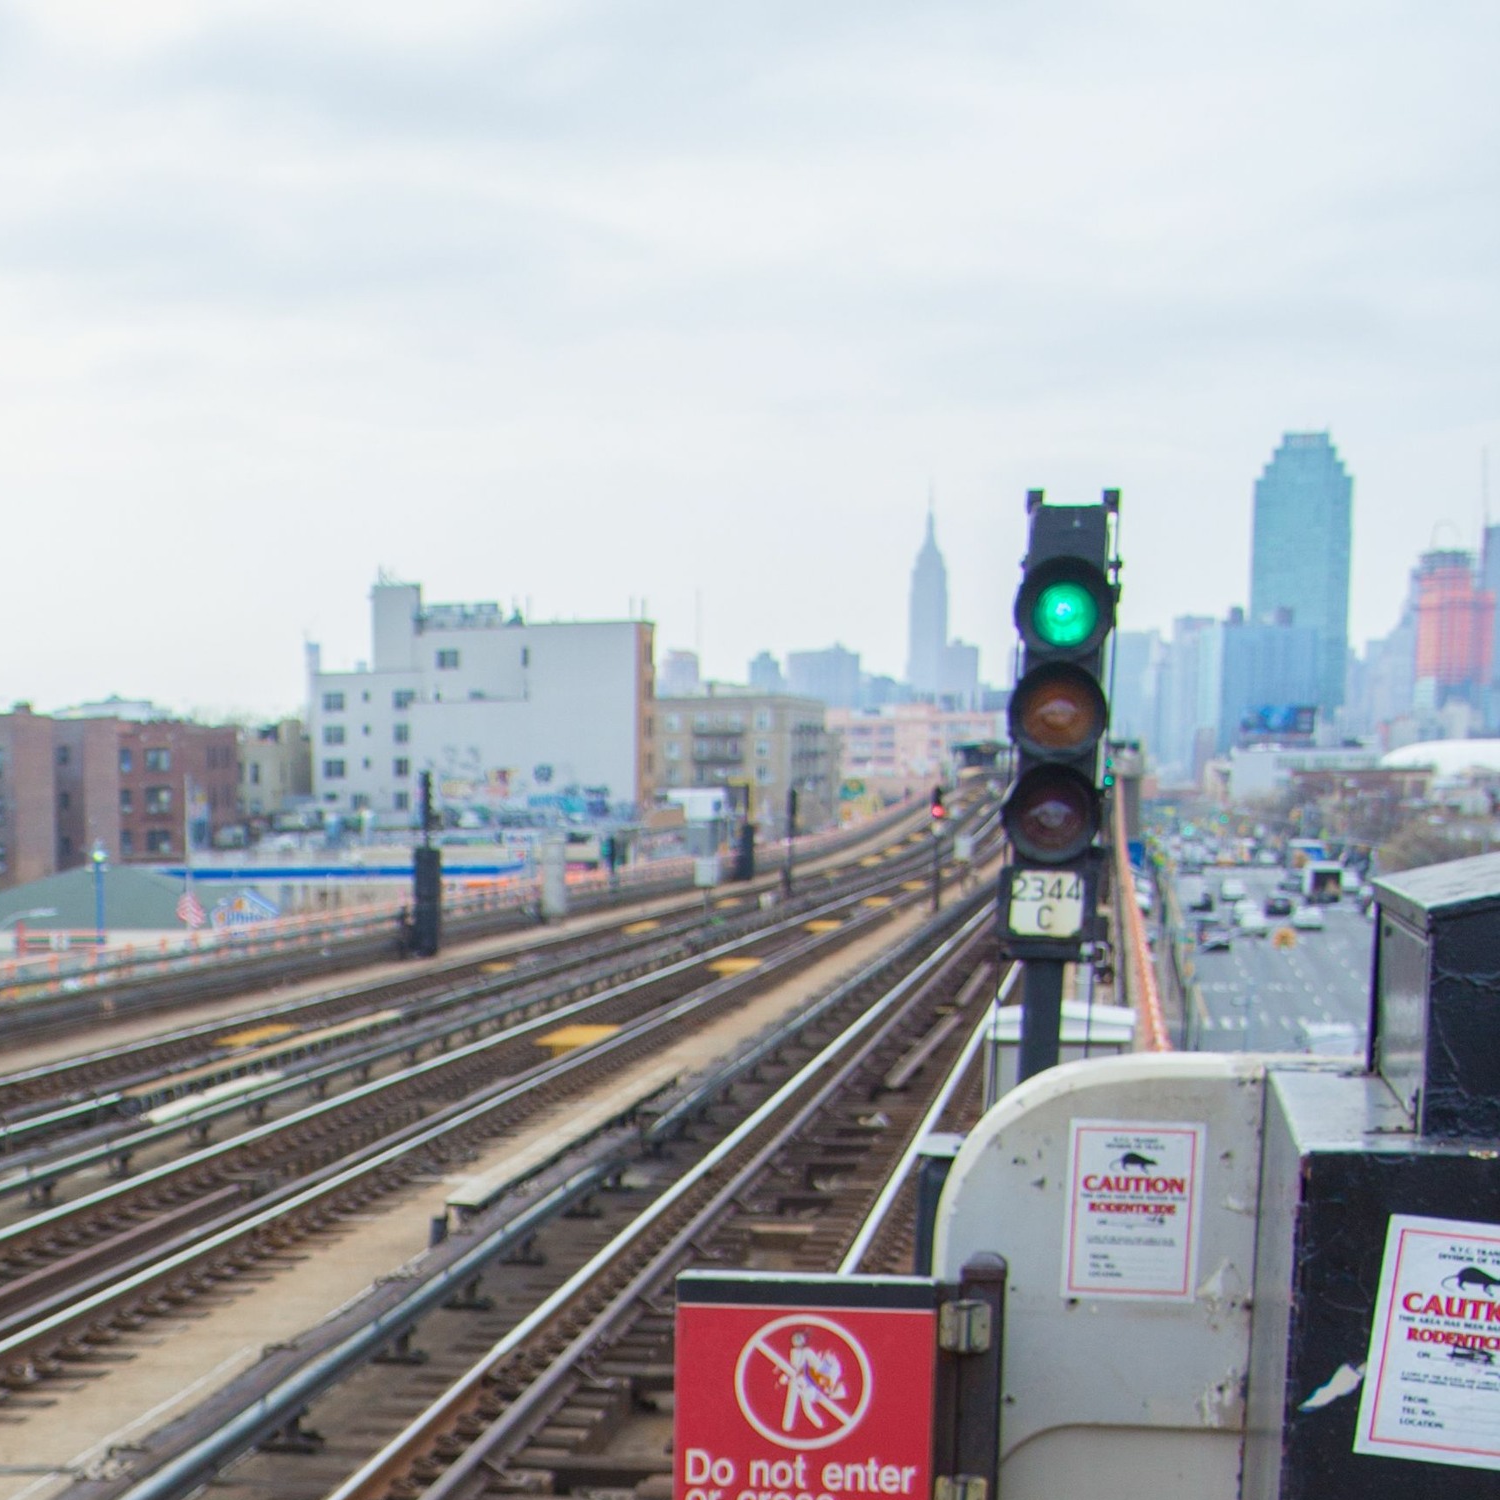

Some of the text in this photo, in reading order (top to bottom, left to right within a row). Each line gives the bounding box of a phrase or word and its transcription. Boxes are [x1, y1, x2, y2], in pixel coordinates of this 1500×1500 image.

[1012, 877, 1081, 901] 2344
[1036, 904, 1053, 930] C
[1082, 1174, 1187, 1194] CAUTION
[1088, 1202, 1177, 1217] RODENTICIDE
[685, 1449, 916, 1494] Do not enter
